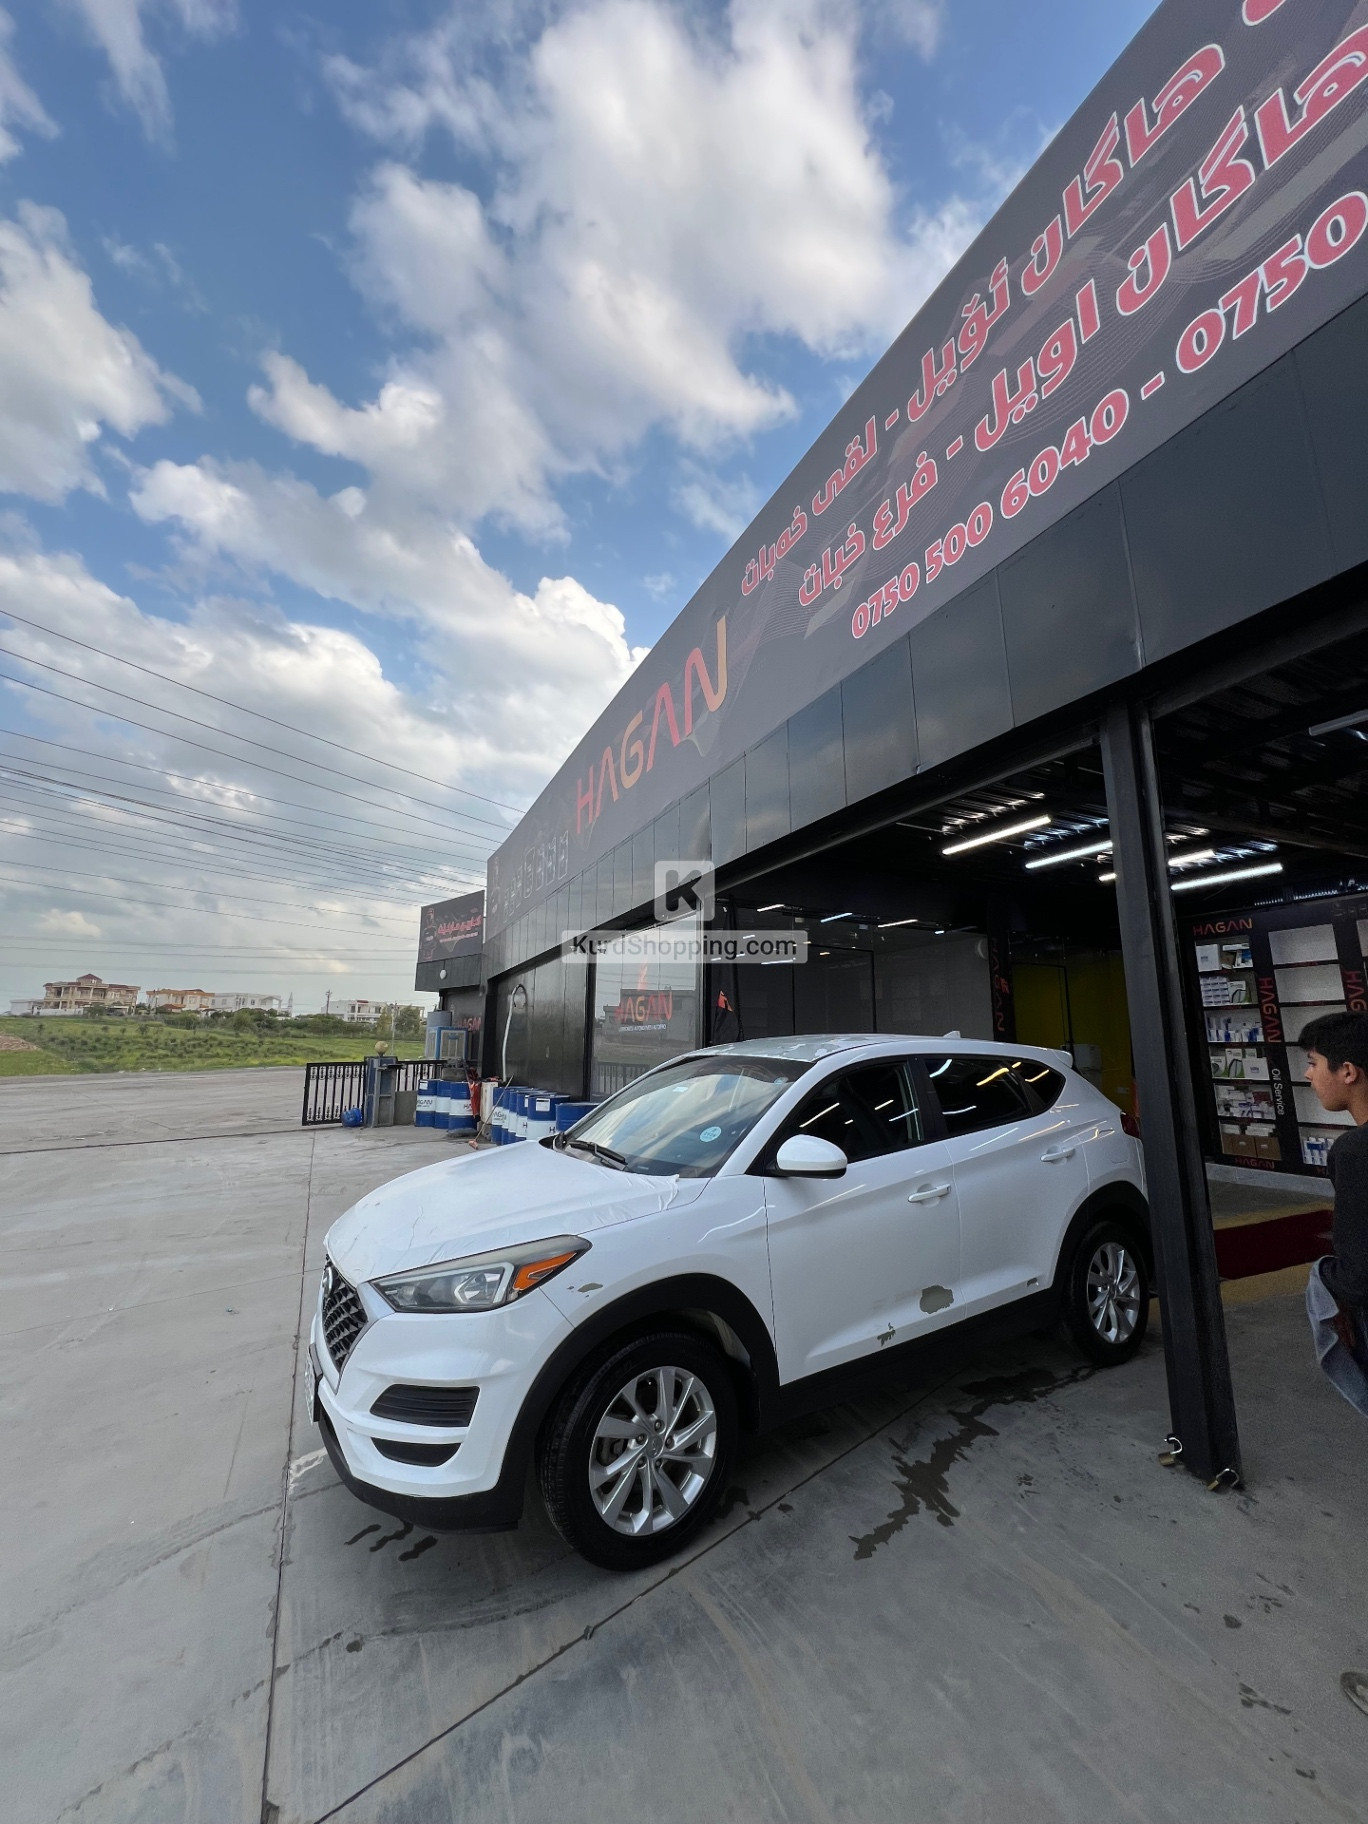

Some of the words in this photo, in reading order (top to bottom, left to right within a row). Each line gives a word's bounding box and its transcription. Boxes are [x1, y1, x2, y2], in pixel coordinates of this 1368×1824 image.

[851, 561, 921, 639] 0750
[925, 501, 994, 584] 500
[1000, 388, 1130, 520] 6040
[1176, 190, 1368, 374] 0750
[872, 450, 939, 551] فرع
[798, 522, 866, 607] خبات
[576, 615, 728, 835] HAGAN
[1193, 918, 1253, 936] HAGAN
[1258, 977, 1282, 1043] HAGAN
[1343, 971, 1368, 1012] HAG
[1271, 1068, 1281, 1081] Oil
[1273, 1083, 1285, 1116] Service
